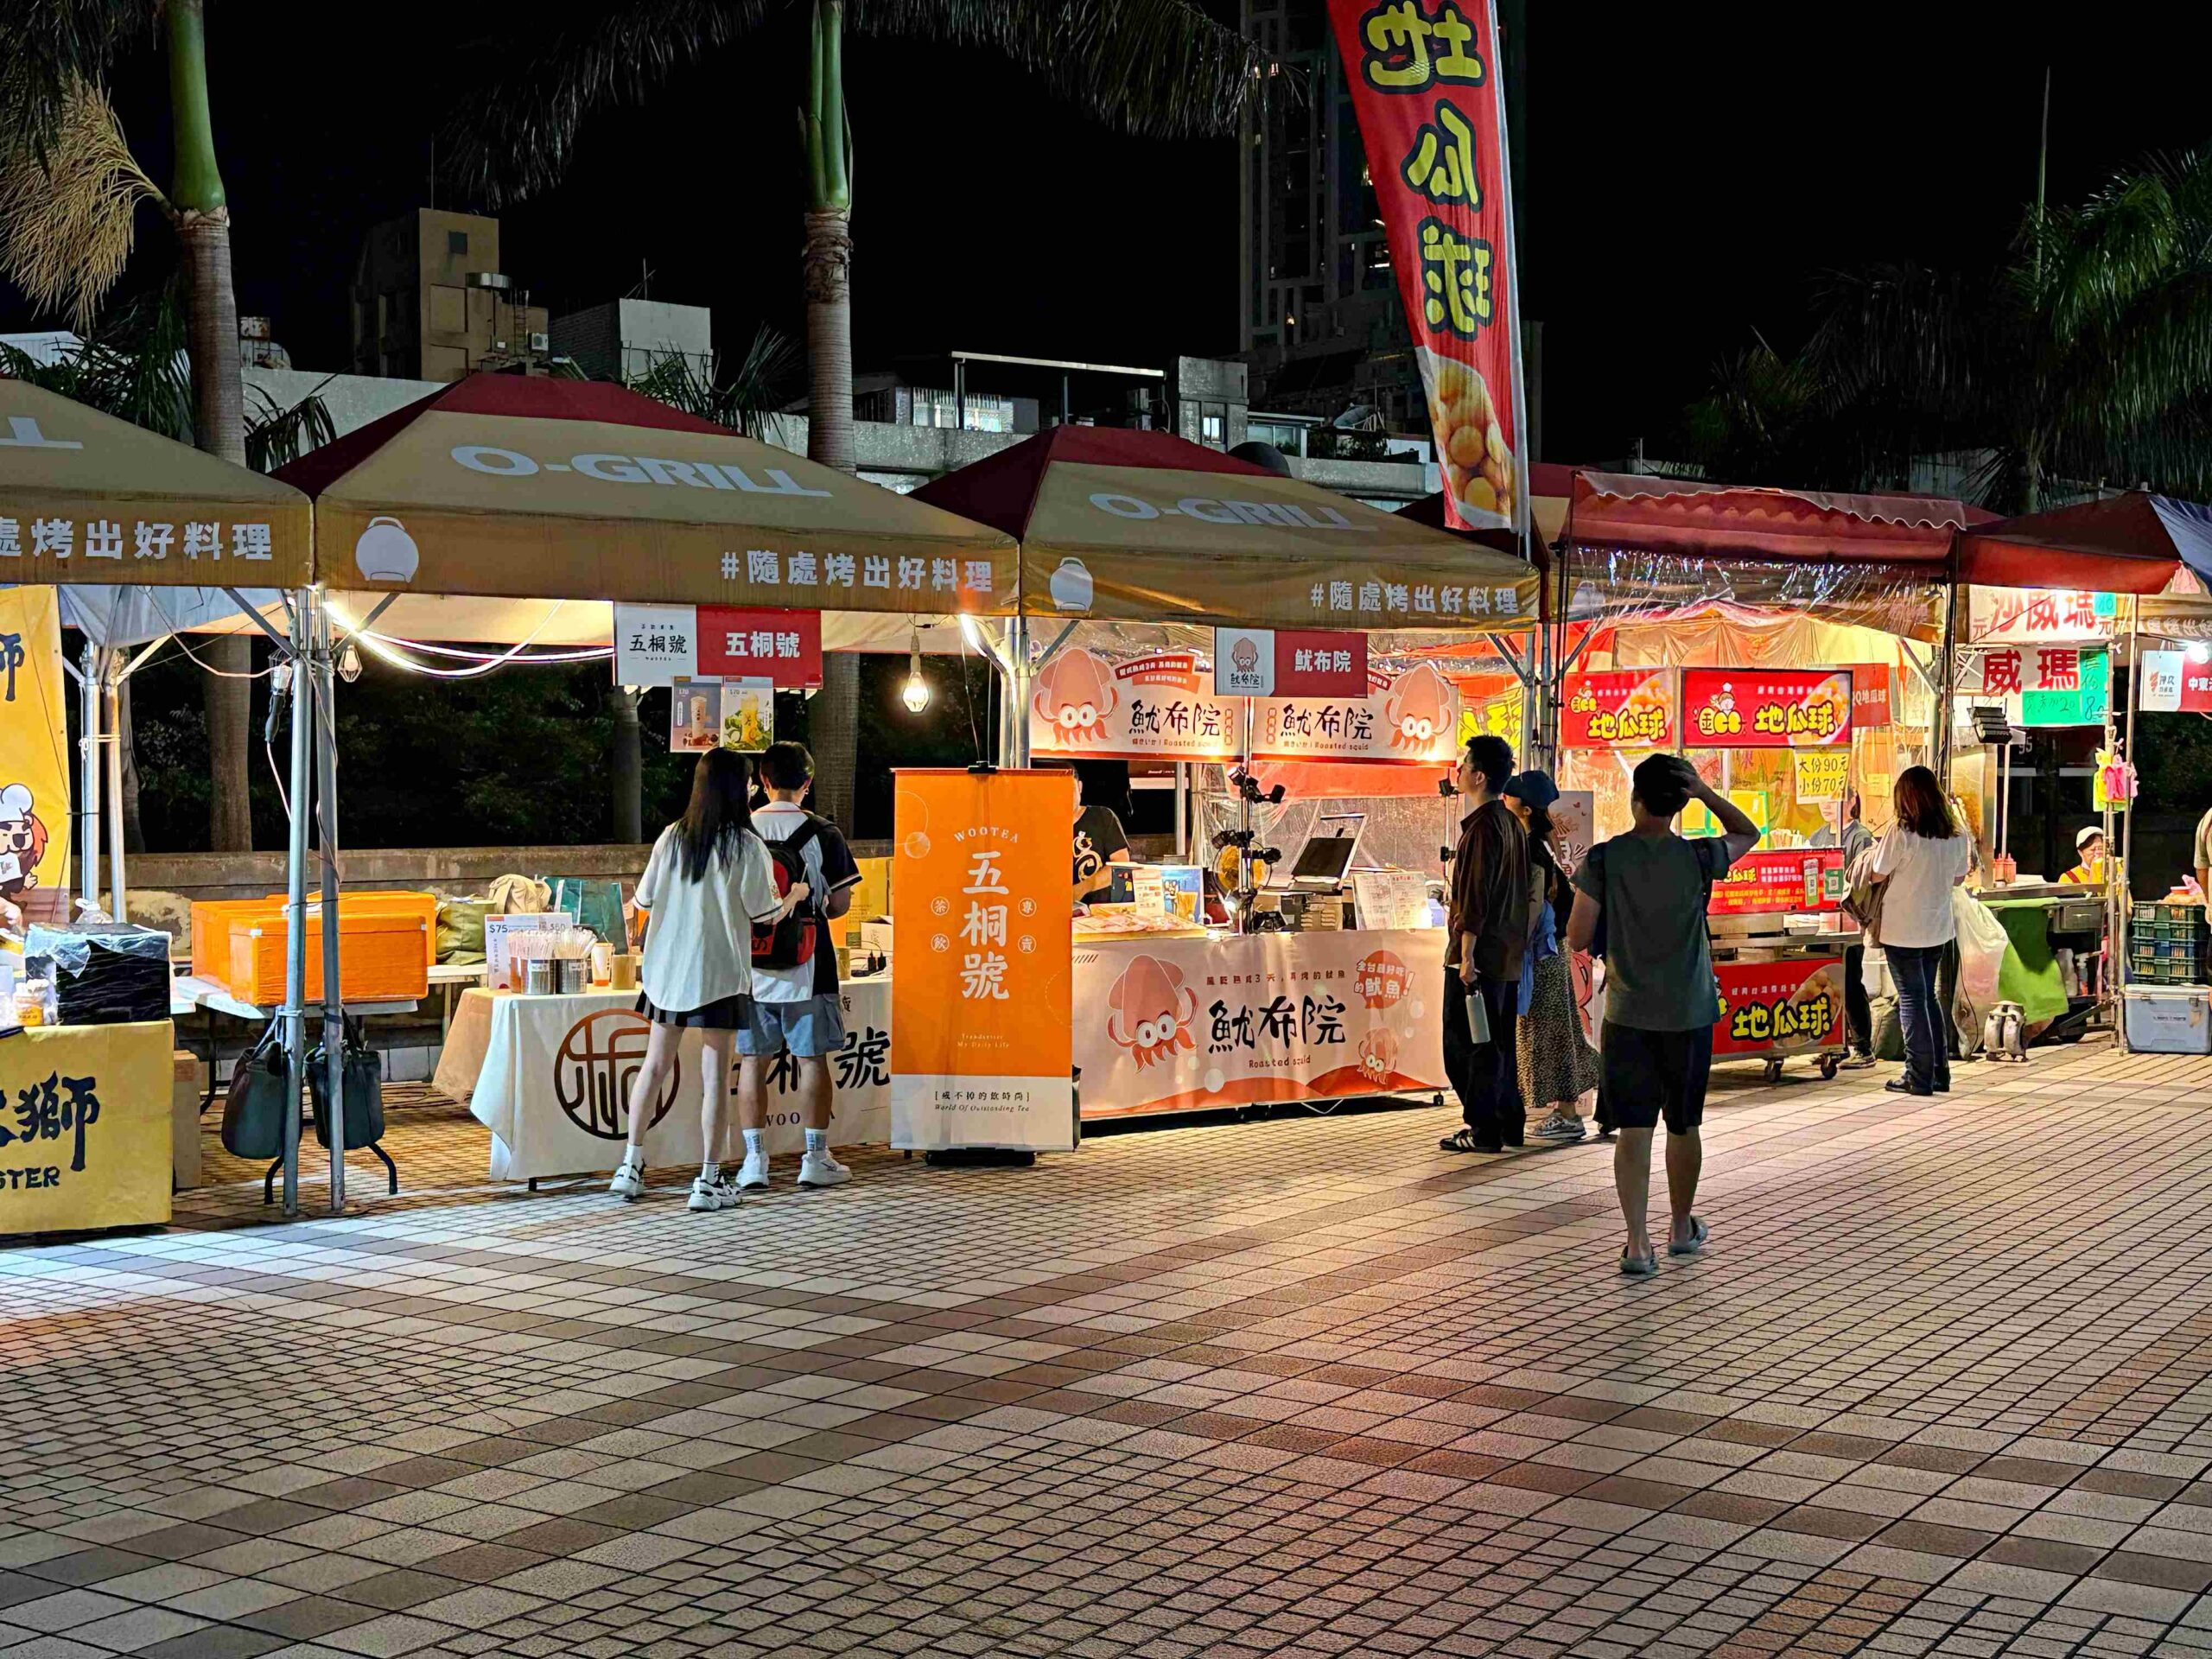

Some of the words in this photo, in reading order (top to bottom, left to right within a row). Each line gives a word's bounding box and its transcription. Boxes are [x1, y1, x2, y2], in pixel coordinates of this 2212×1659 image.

[451, 446, 834, 498] O-GRILL
[1089, 493, 1377, 531] O-GRILL
[721, 550, 993, 593] #隨處烤出好料理
[1310, 581, 1518, 614] #隨處烤出好料理
[629, 634, 687, 653] 五桐號
[725, 632, 801, 658] 五桐號
[1294, 649, 1351, 673] 魷布院
[1129, 699, 1221, 736] 魷布院
[1281, 703, 1374, 741] 魷布院
[1588, 708, 1666, 741] 地瓜球
[1755, 701, 1836, 736] 地瓜球
[1799, 756, 1848, 773] 大份90元
[954, 827, 1018, 843] WOOTEA
[489, 925, 508, 934] $75
[959, 850, 1009, 1000] 五桐號
[1208, 995, 1346, 1054] 魷布院
[1732, 995, 1831, 1039] 地瓜球
[1249, 1056, 1289, 1069] Roasted
[0, 1070, 100, 1173] 獅
